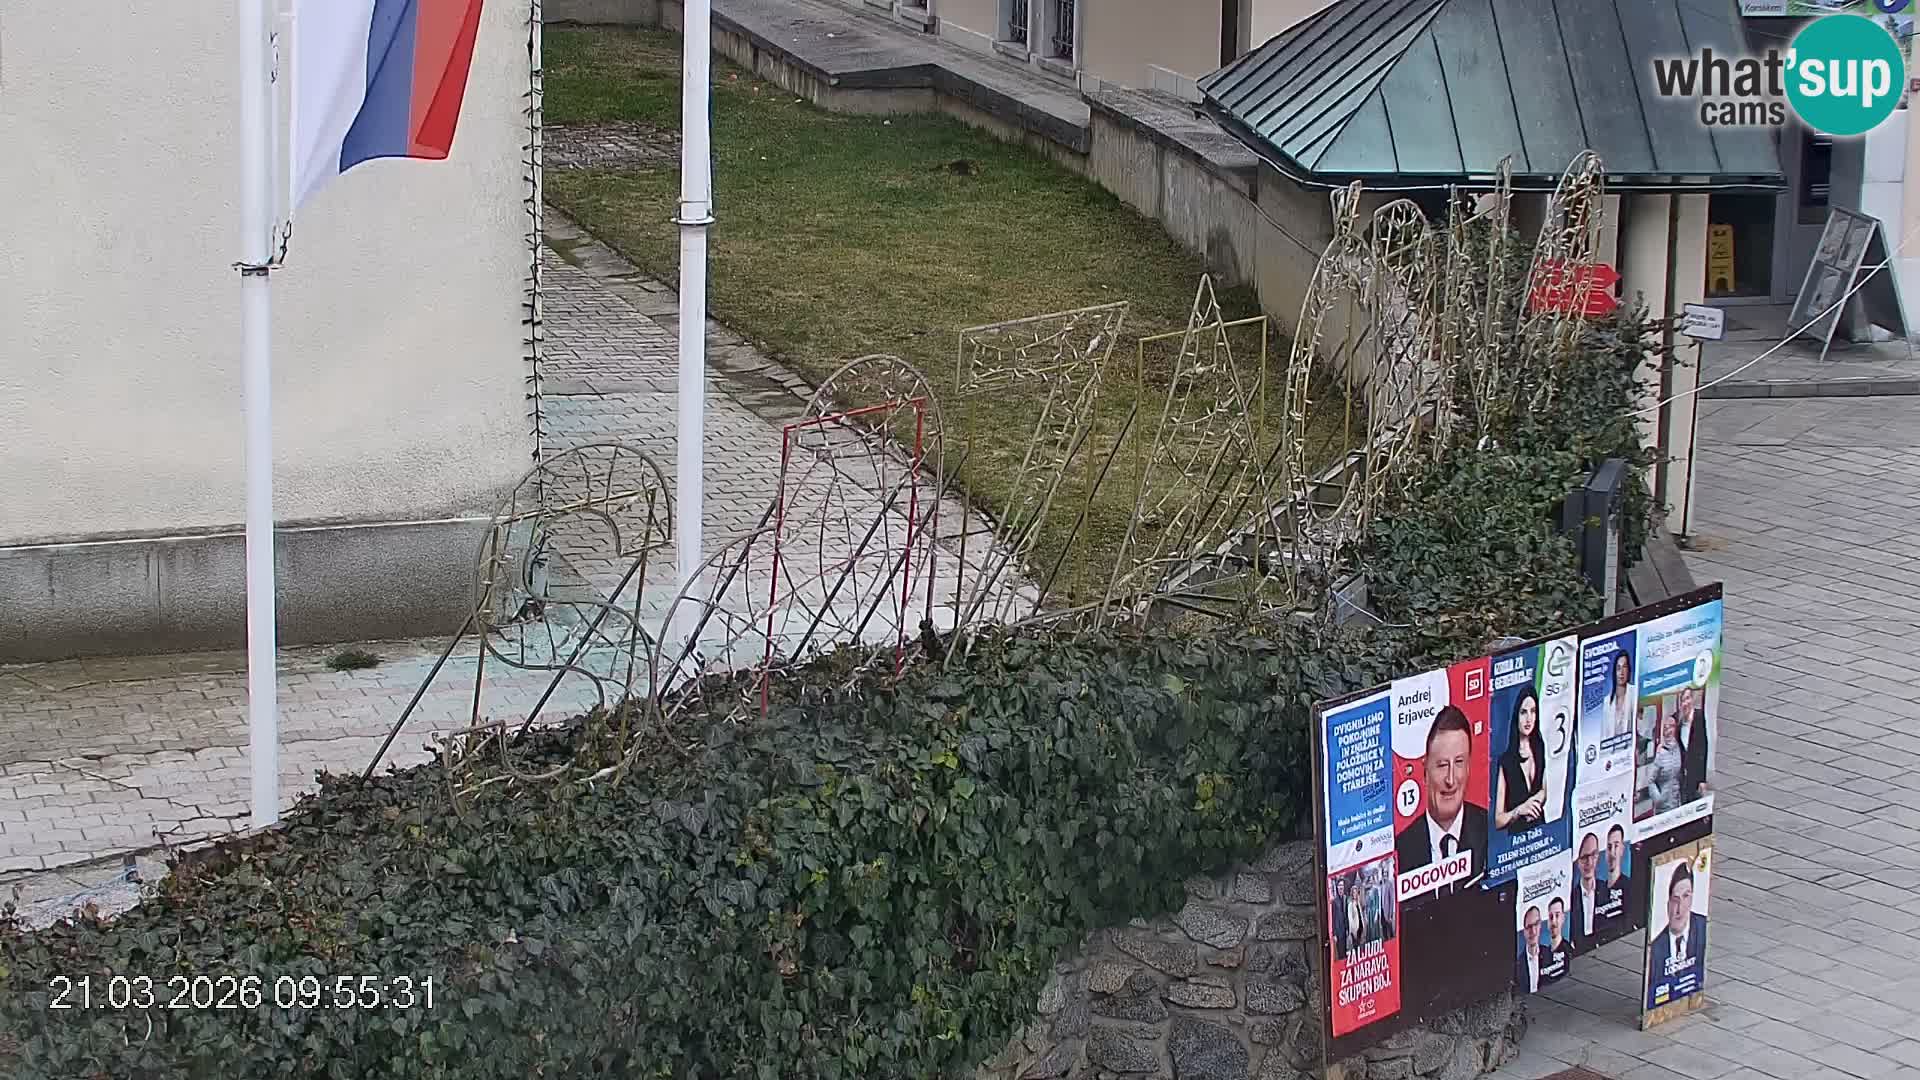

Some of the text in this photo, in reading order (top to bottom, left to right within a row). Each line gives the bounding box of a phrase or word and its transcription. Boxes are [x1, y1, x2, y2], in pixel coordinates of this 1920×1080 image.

[1468, 679, 1480, 691] SD
[1398, 686, 1432, 708] Andrej
[1334, 712, 1384, 736] DVIGNILI SMO
[1398, 705, 1435, 726] Erjavec
[1338, 724, 1380, 747] POKOJNINE
[1554, 712, 1566, 755] 3
[1341, 736, 1379, 758] IN ZNIŽALI
[1336, 746, 1384, 772] POLOŽNICE V
[1337, 759, 1385, 784] DOMOVIH ZA
[1402, 788, 1415, 807] 13
[1512, 827, 1543, 847] Ana Taks
[1496, 849, 1518, 865] ZELENI
[1518, 839, 1549, 860] SLOVENIJE
[1401, 857, 1467, 896] DOGOVOR
[1346, 948, 1357, 968] ZA
[1340, 954, 1389, 989] ZA NARAVO.
[1338, 969, 1392, 1007] SKUPEN BOJ.
